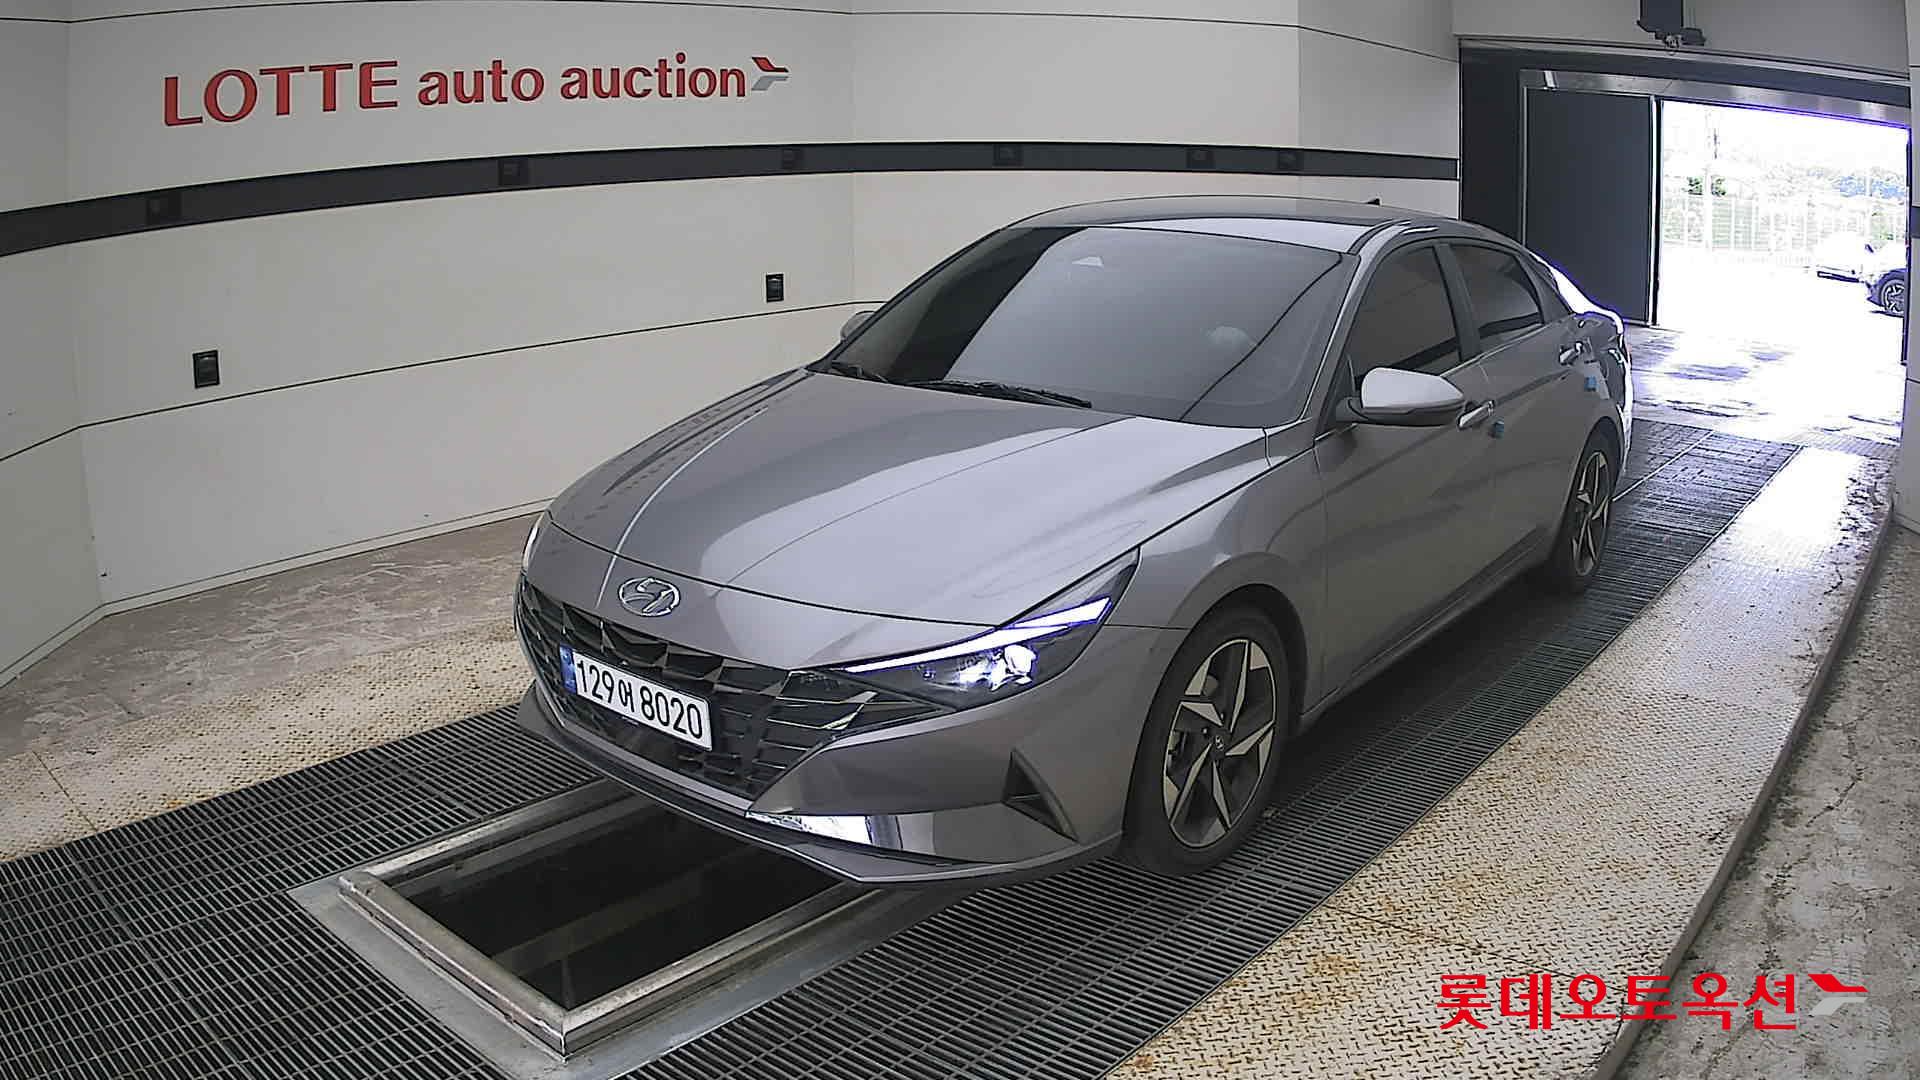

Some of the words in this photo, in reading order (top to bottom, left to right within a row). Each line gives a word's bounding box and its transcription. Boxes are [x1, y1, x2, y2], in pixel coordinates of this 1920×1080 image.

[163, 60, 398, 127] LOTTE
[417, 59, 545, 106] auto
[559, 52, 746, 100] auction
[576, 660, 635, 713] 129어
[639, 685, 703, 739] 8020
